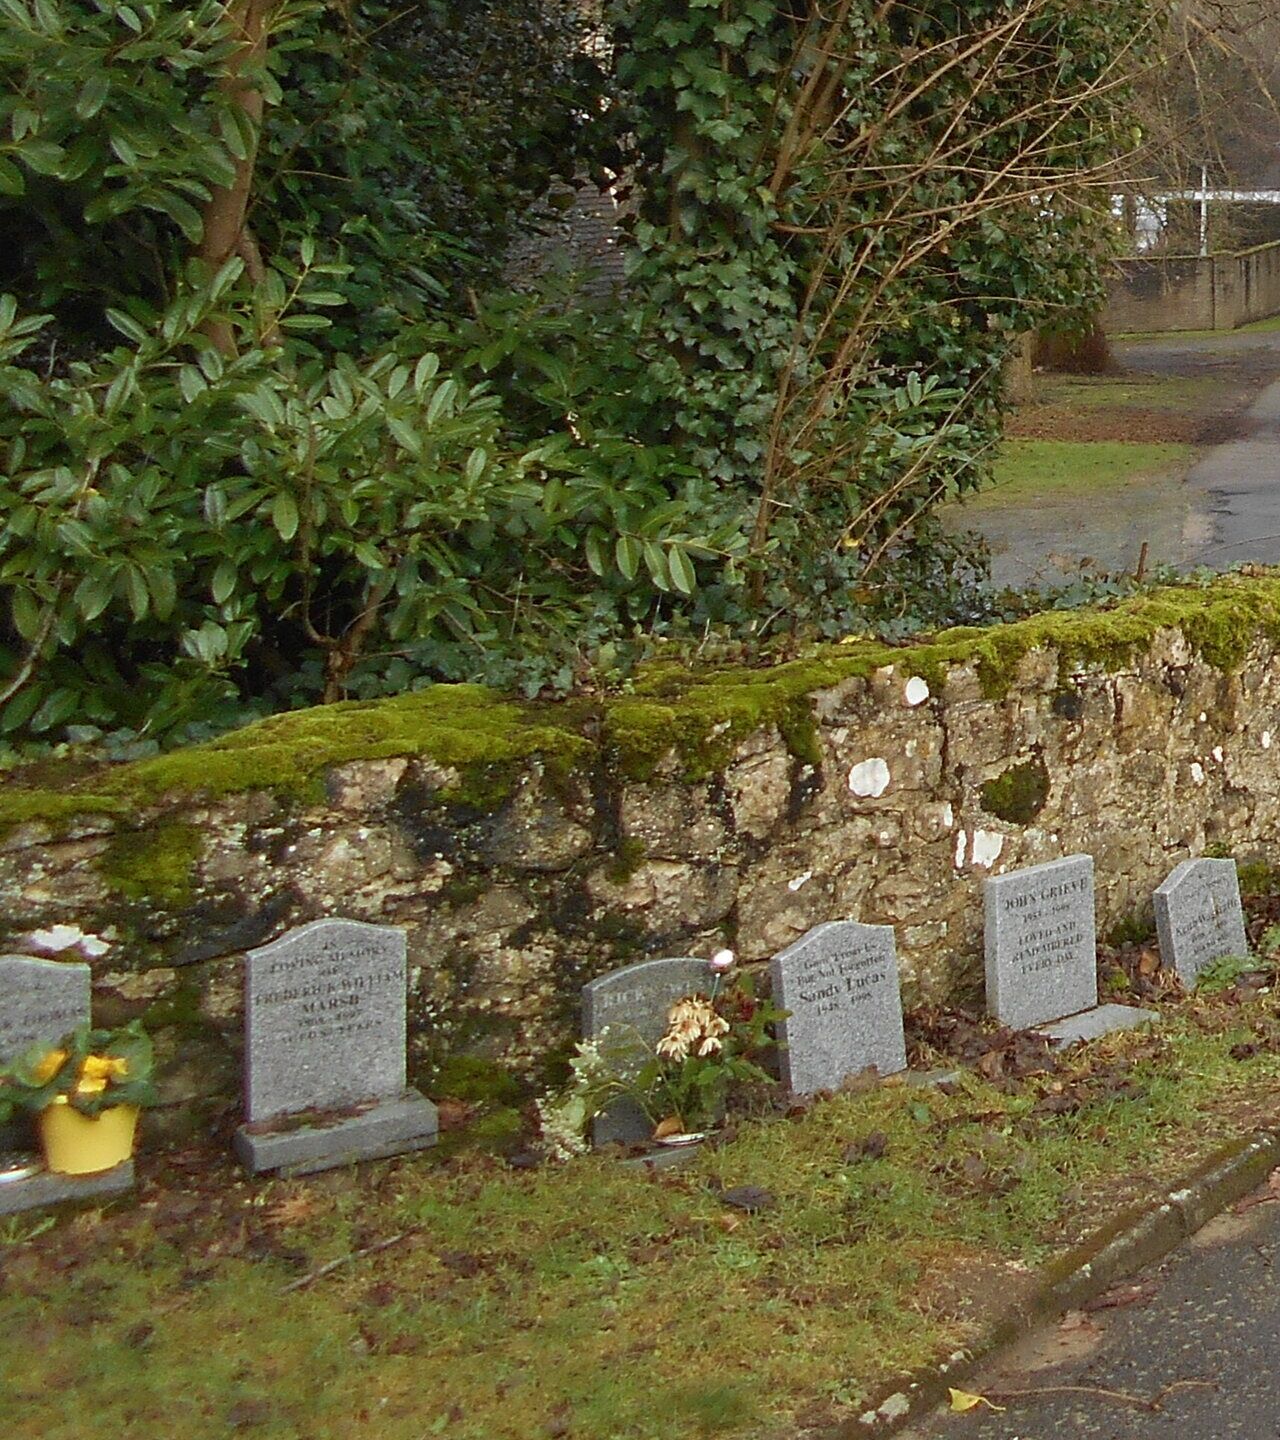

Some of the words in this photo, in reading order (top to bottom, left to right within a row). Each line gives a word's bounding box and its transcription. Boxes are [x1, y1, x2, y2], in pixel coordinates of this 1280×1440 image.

[1005, 893, 1037, 910] JOHN
[1040, 877, 1088, 900] GRIEVE
[799, 983, 840, 1003] Sandy
[845, 972, 887, 992] Lucas
